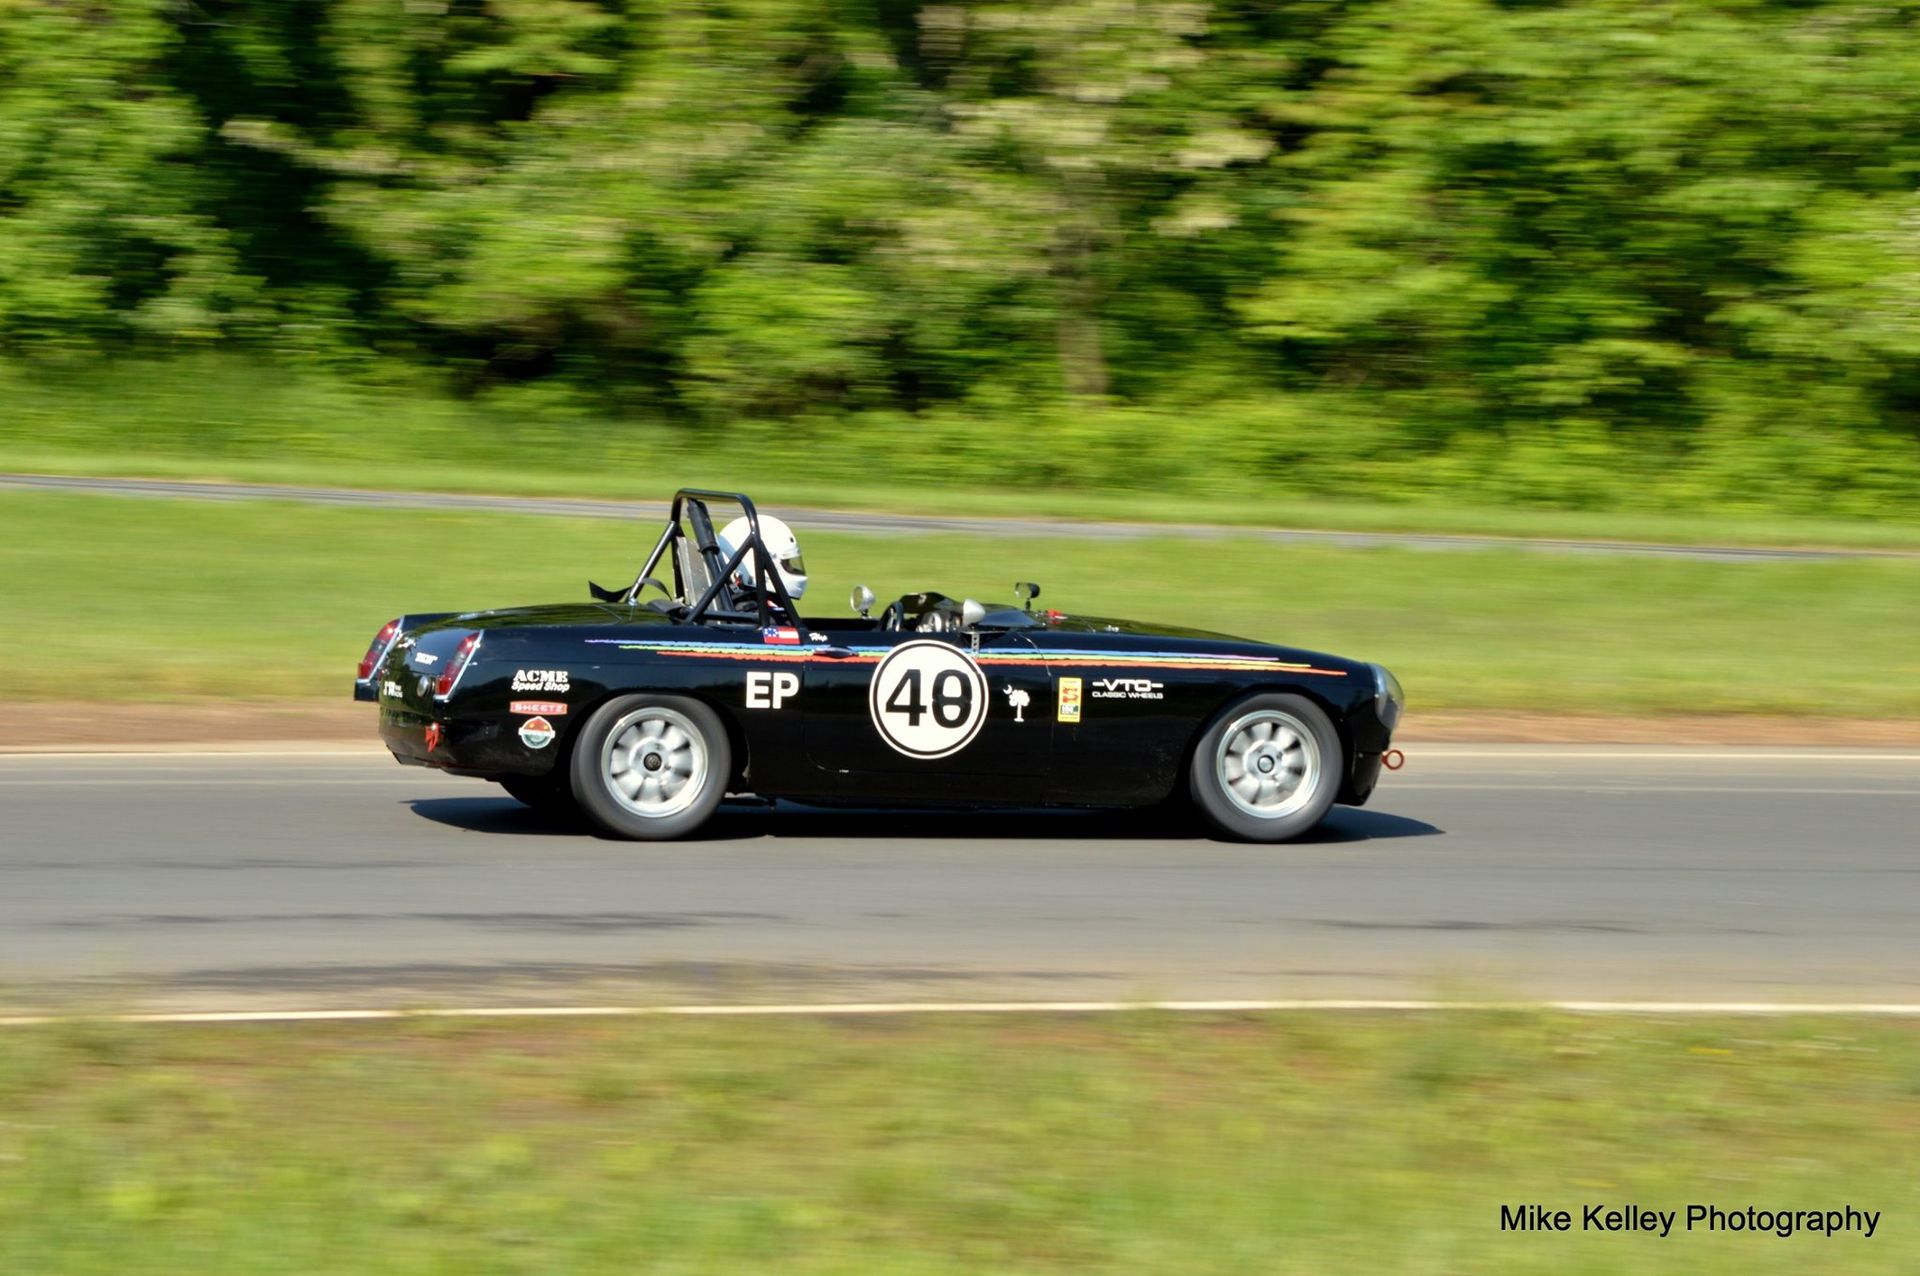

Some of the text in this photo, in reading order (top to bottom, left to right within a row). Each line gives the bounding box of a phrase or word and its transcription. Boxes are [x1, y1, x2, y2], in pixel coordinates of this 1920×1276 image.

[513, 669, 569, 683] ACME
[511, 681, 571, 693] Speed Shop
[745, 671, 799, 709] EP
[1091, 691, 1164, 700] CLASSIC WHEELS
[514, 704, 564, 713] SHEETZ
